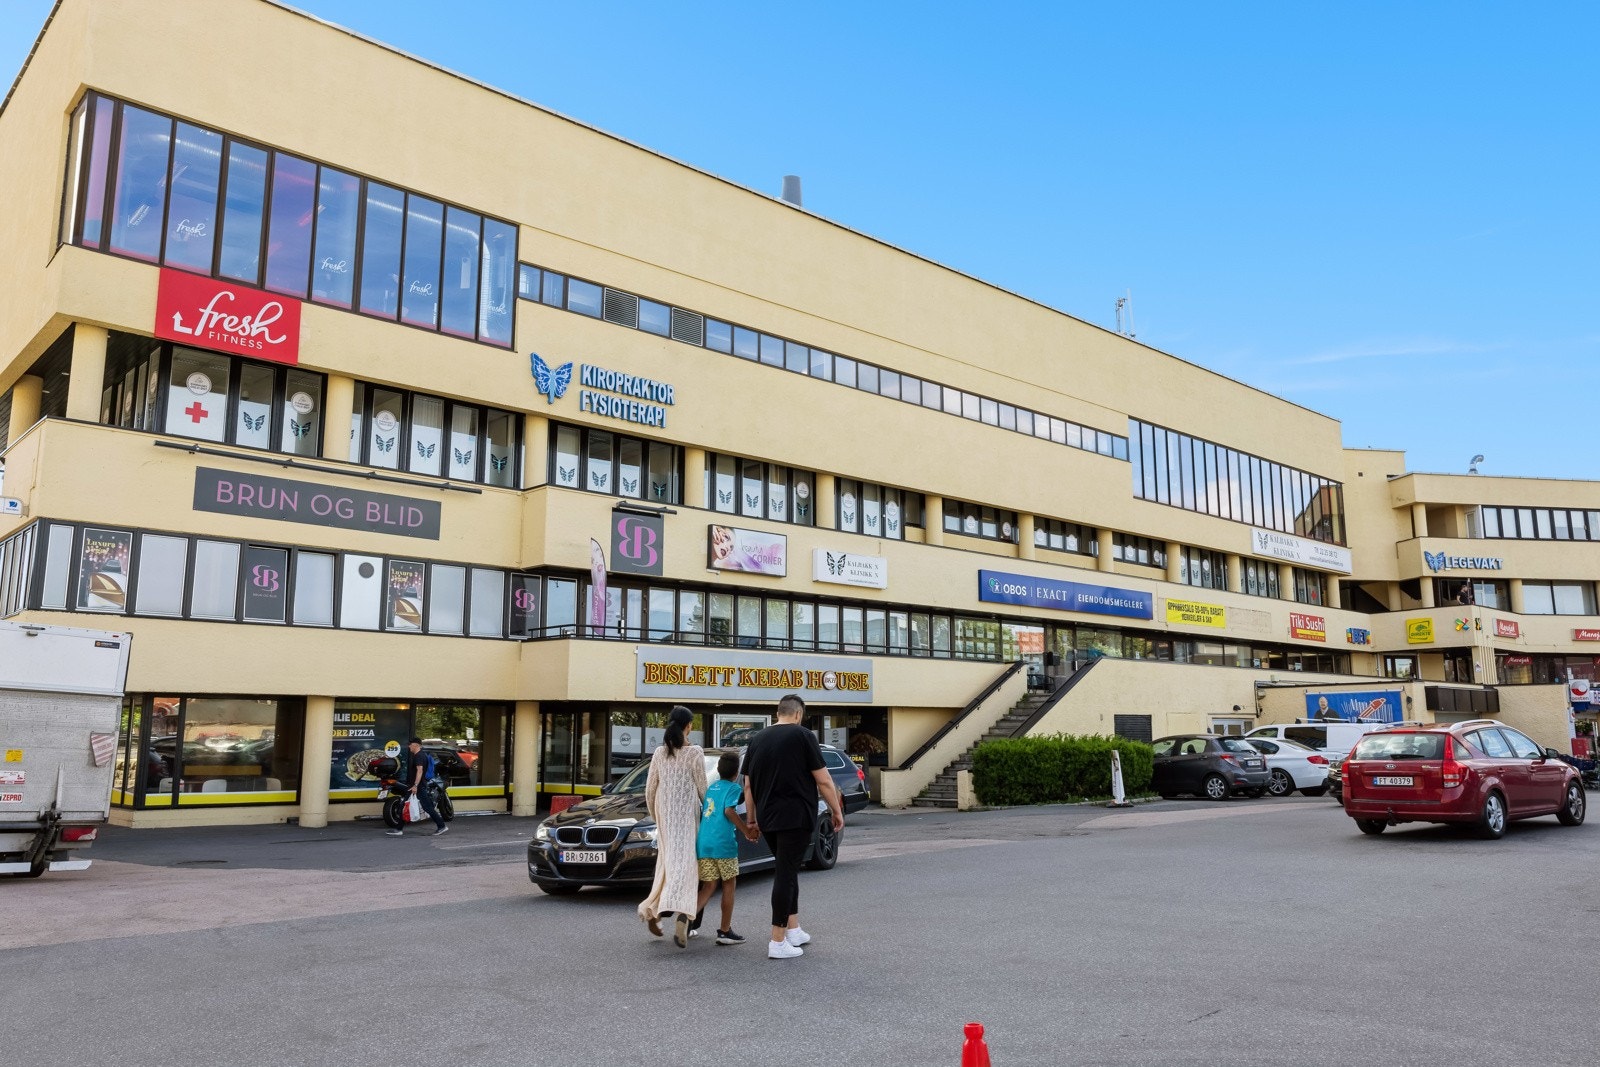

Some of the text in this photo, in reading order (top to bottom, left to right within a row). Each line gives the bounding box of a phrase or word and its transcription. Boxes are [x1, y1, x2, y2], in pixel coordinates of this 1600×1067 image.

[177, 219, 206, 236] fresh
[322, 256, 349, 273] fresh
[410, 280, 433, 296] fresh
[194, 291, 287, 344] fresh
[208, 331, 263, 350] FITNESS
[580, 363, 675, 405] KIROPRAKTOR
[580, 390, 667, 428] FYSIOTERAPI
[216, 480, 424, 528] BRUN OG BLID
[752, 553, 782, 566] CORNER
[1444, 556, 1503, 570] LEGEVAKT
[1003, 583, 1143, 610] OBOS EXACT EIENDOMSMEGLERE
[1290, 614, 1325, 631] Tiki Sushi
[644, 662, 870, 691] BISLETT KEBAB HOUSE
[351, 713, 376, 722] DEAL
[349, 729, 375, 737] PIZZA
[565, 852, 605, 861] BR 97861
